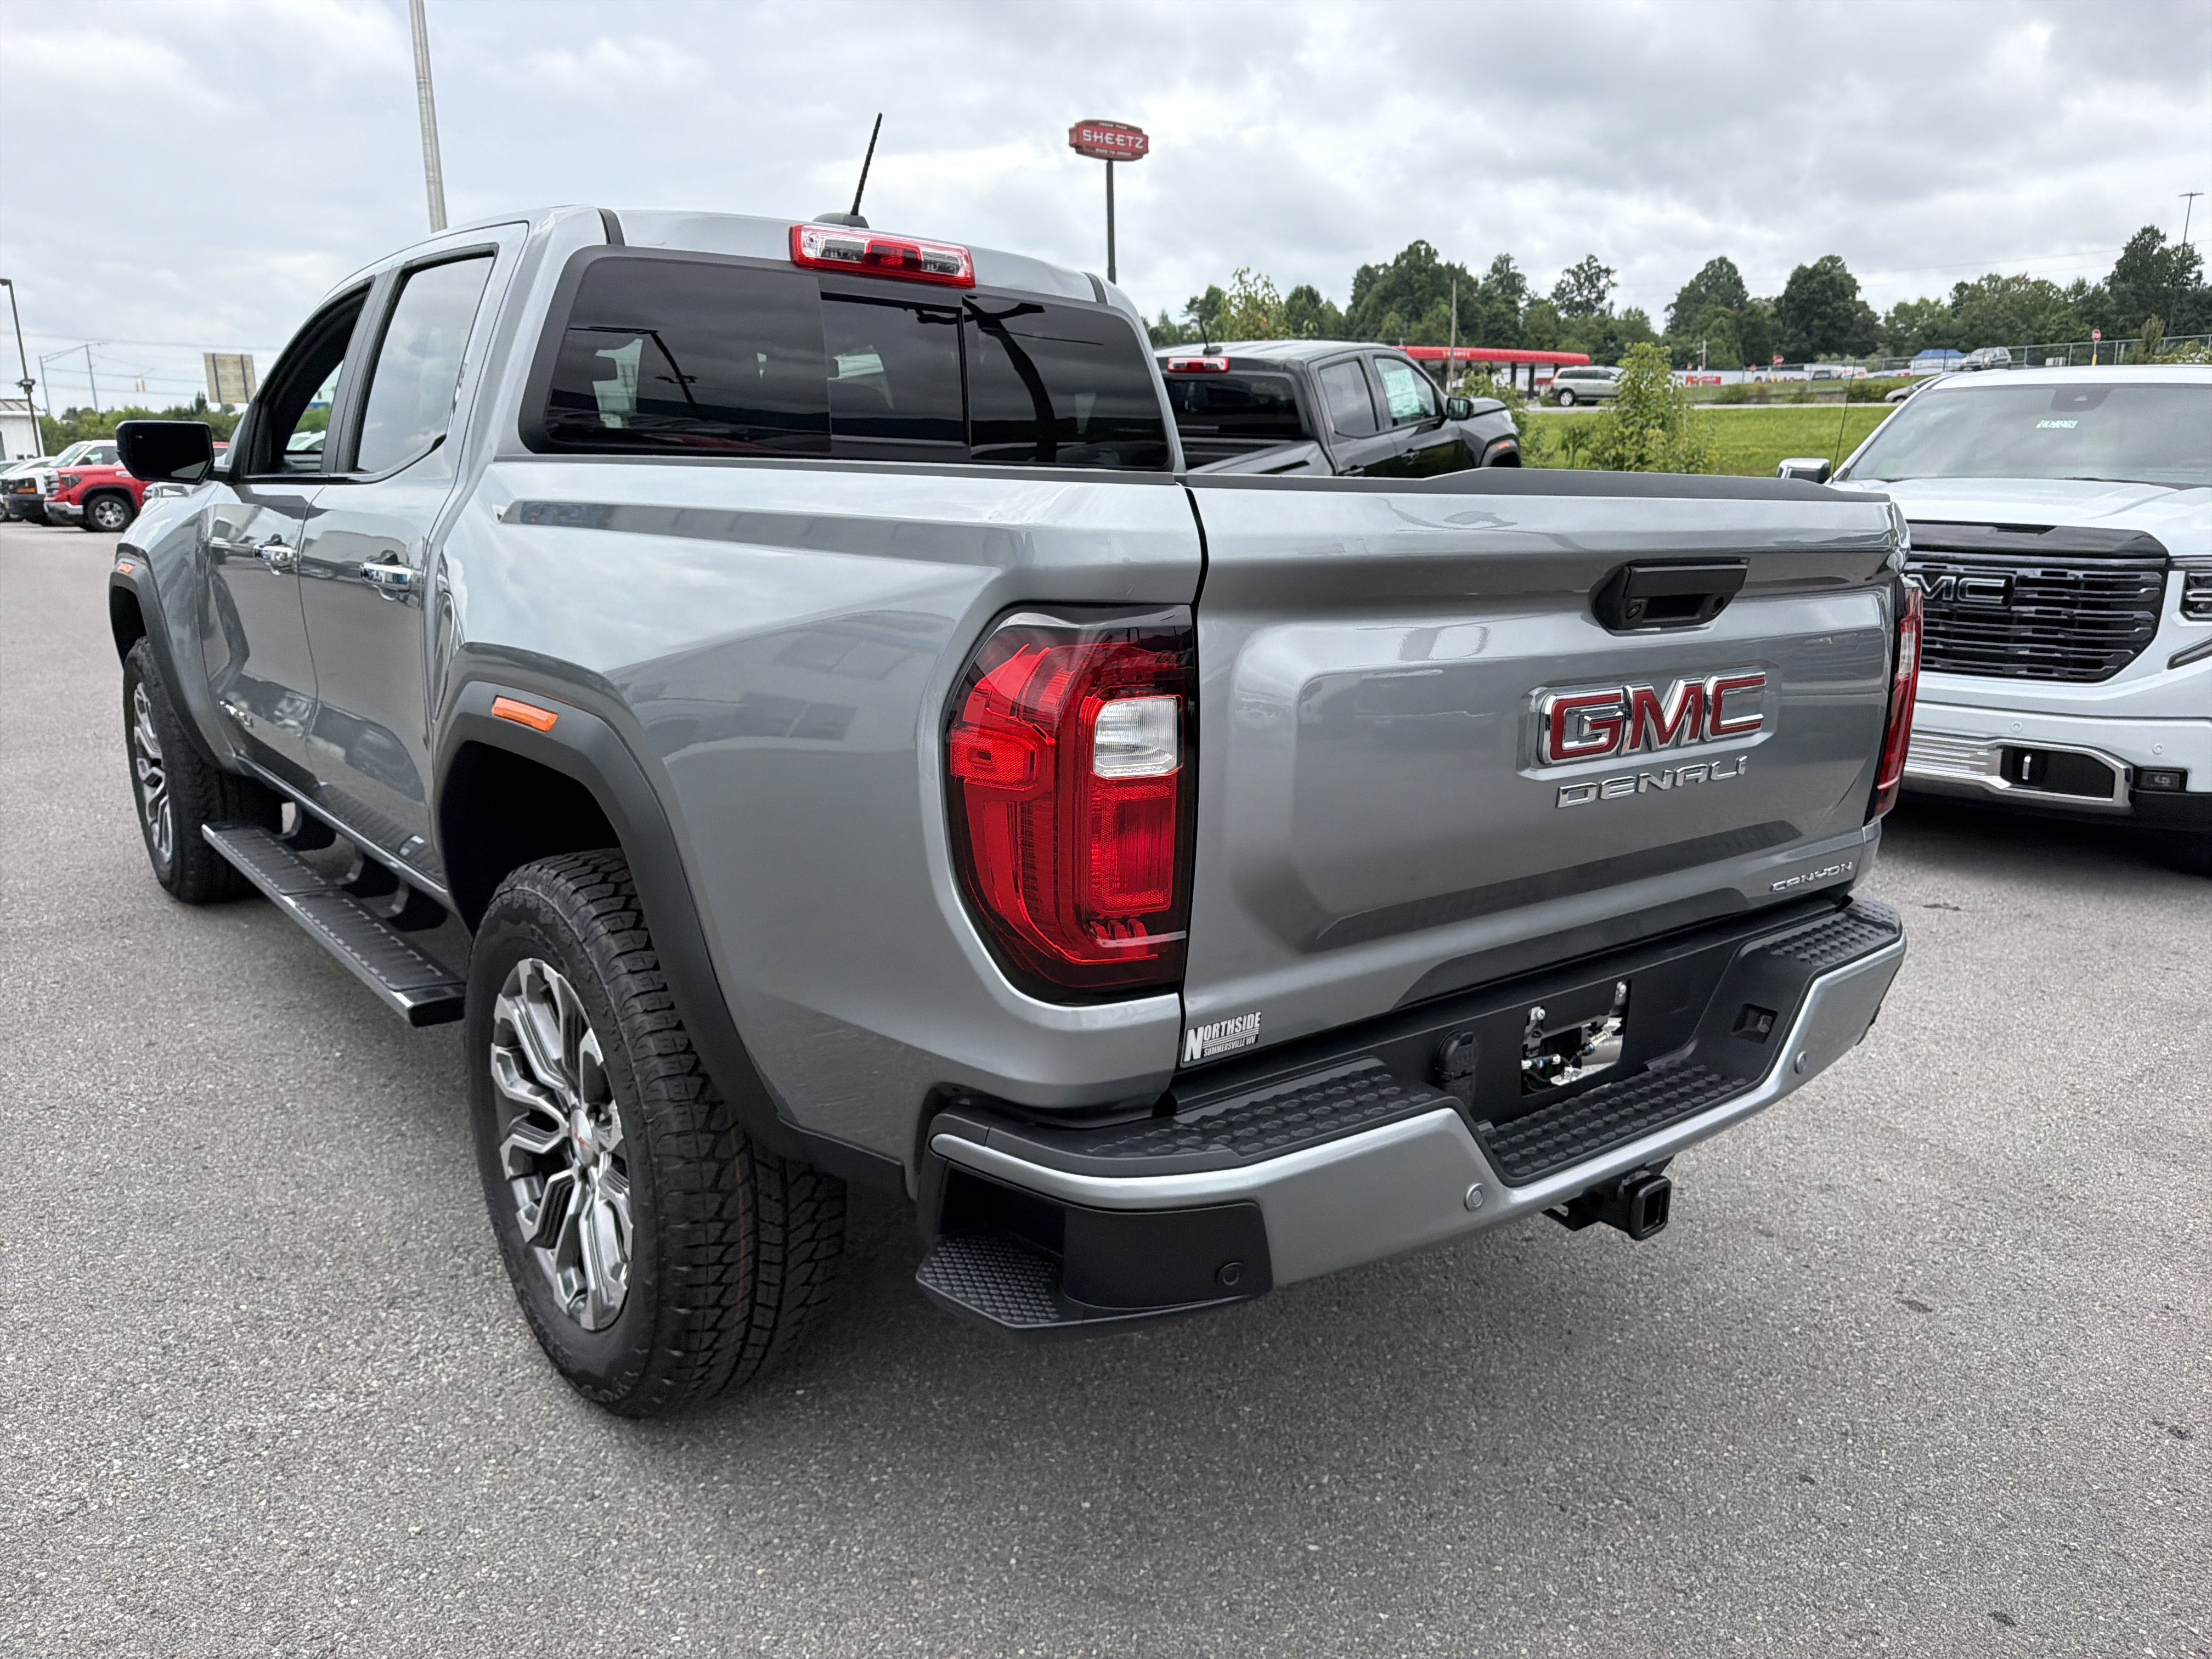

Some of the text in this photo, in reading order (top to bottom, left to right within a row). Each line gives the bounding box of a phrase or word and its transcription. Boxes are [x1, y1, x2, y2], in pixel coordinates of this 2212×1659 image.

[1082, 129, 1144, 149] SHEETZ
[1906, 573, 2006, 605] MC
[1538, 668, 1766, 765] GMC
[1555, 755, 1747, 808] DENALI
[1771, 860, 1853, 892] CANYON
[1183, 1011, 1261, 1062] NORTHSIDE
[1203, 1035, 1256, 1057] SUMMERSVILLE WV
